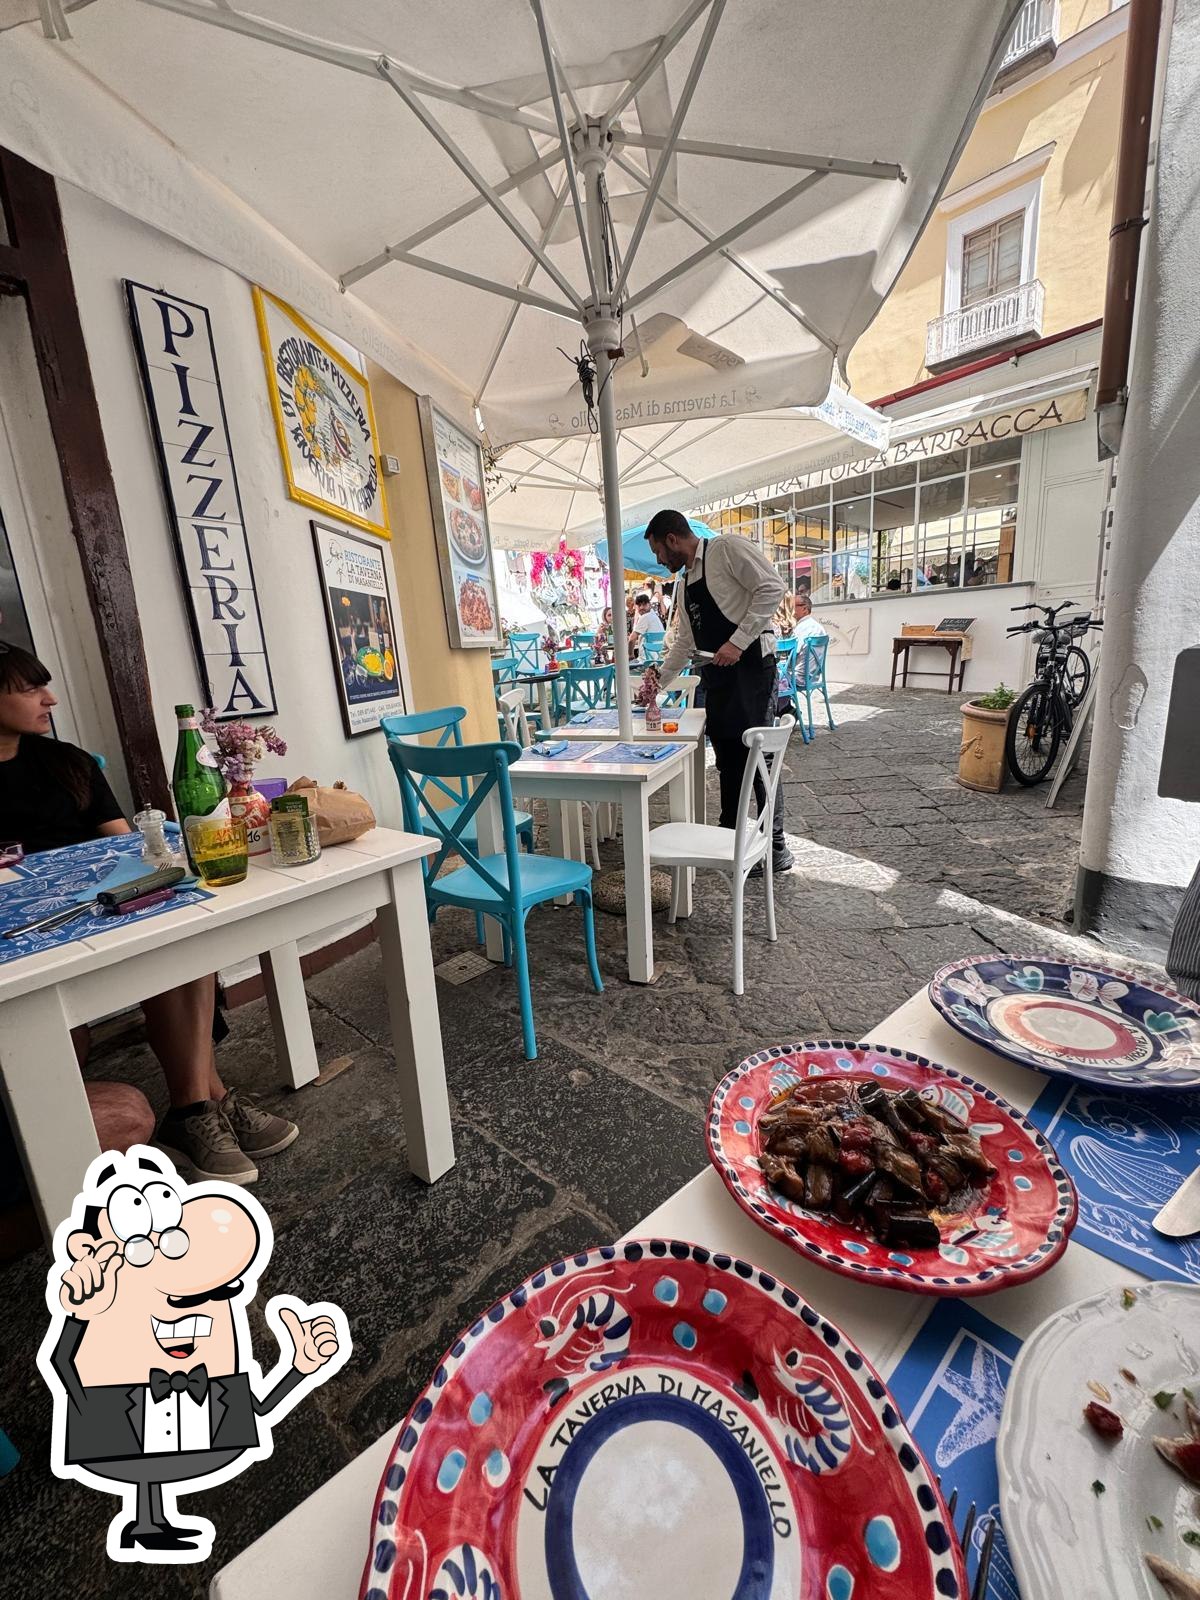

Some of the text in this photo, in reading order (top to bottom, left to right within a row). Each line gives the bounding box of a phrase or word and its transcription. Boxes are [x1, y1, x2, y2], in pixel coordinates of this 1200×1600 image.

[277, 337, 371, 443] RISTORANTE PIZZERIA
[766, 451, 887, 498] TRATTORIA
[893, 400, 1063, 464] BARRACCA
[152, 298, 266, 713] PIZZERIA
[344, 550, 382, 570] RISTORANTE
[346, 562, 383, 581] LA TAVERNA
[348, 574, 355, 584] DI
[247, 830, 261, 843] 16
[523, 1373, 792, 1539] LA TAVERNA DI MASANIELLO
